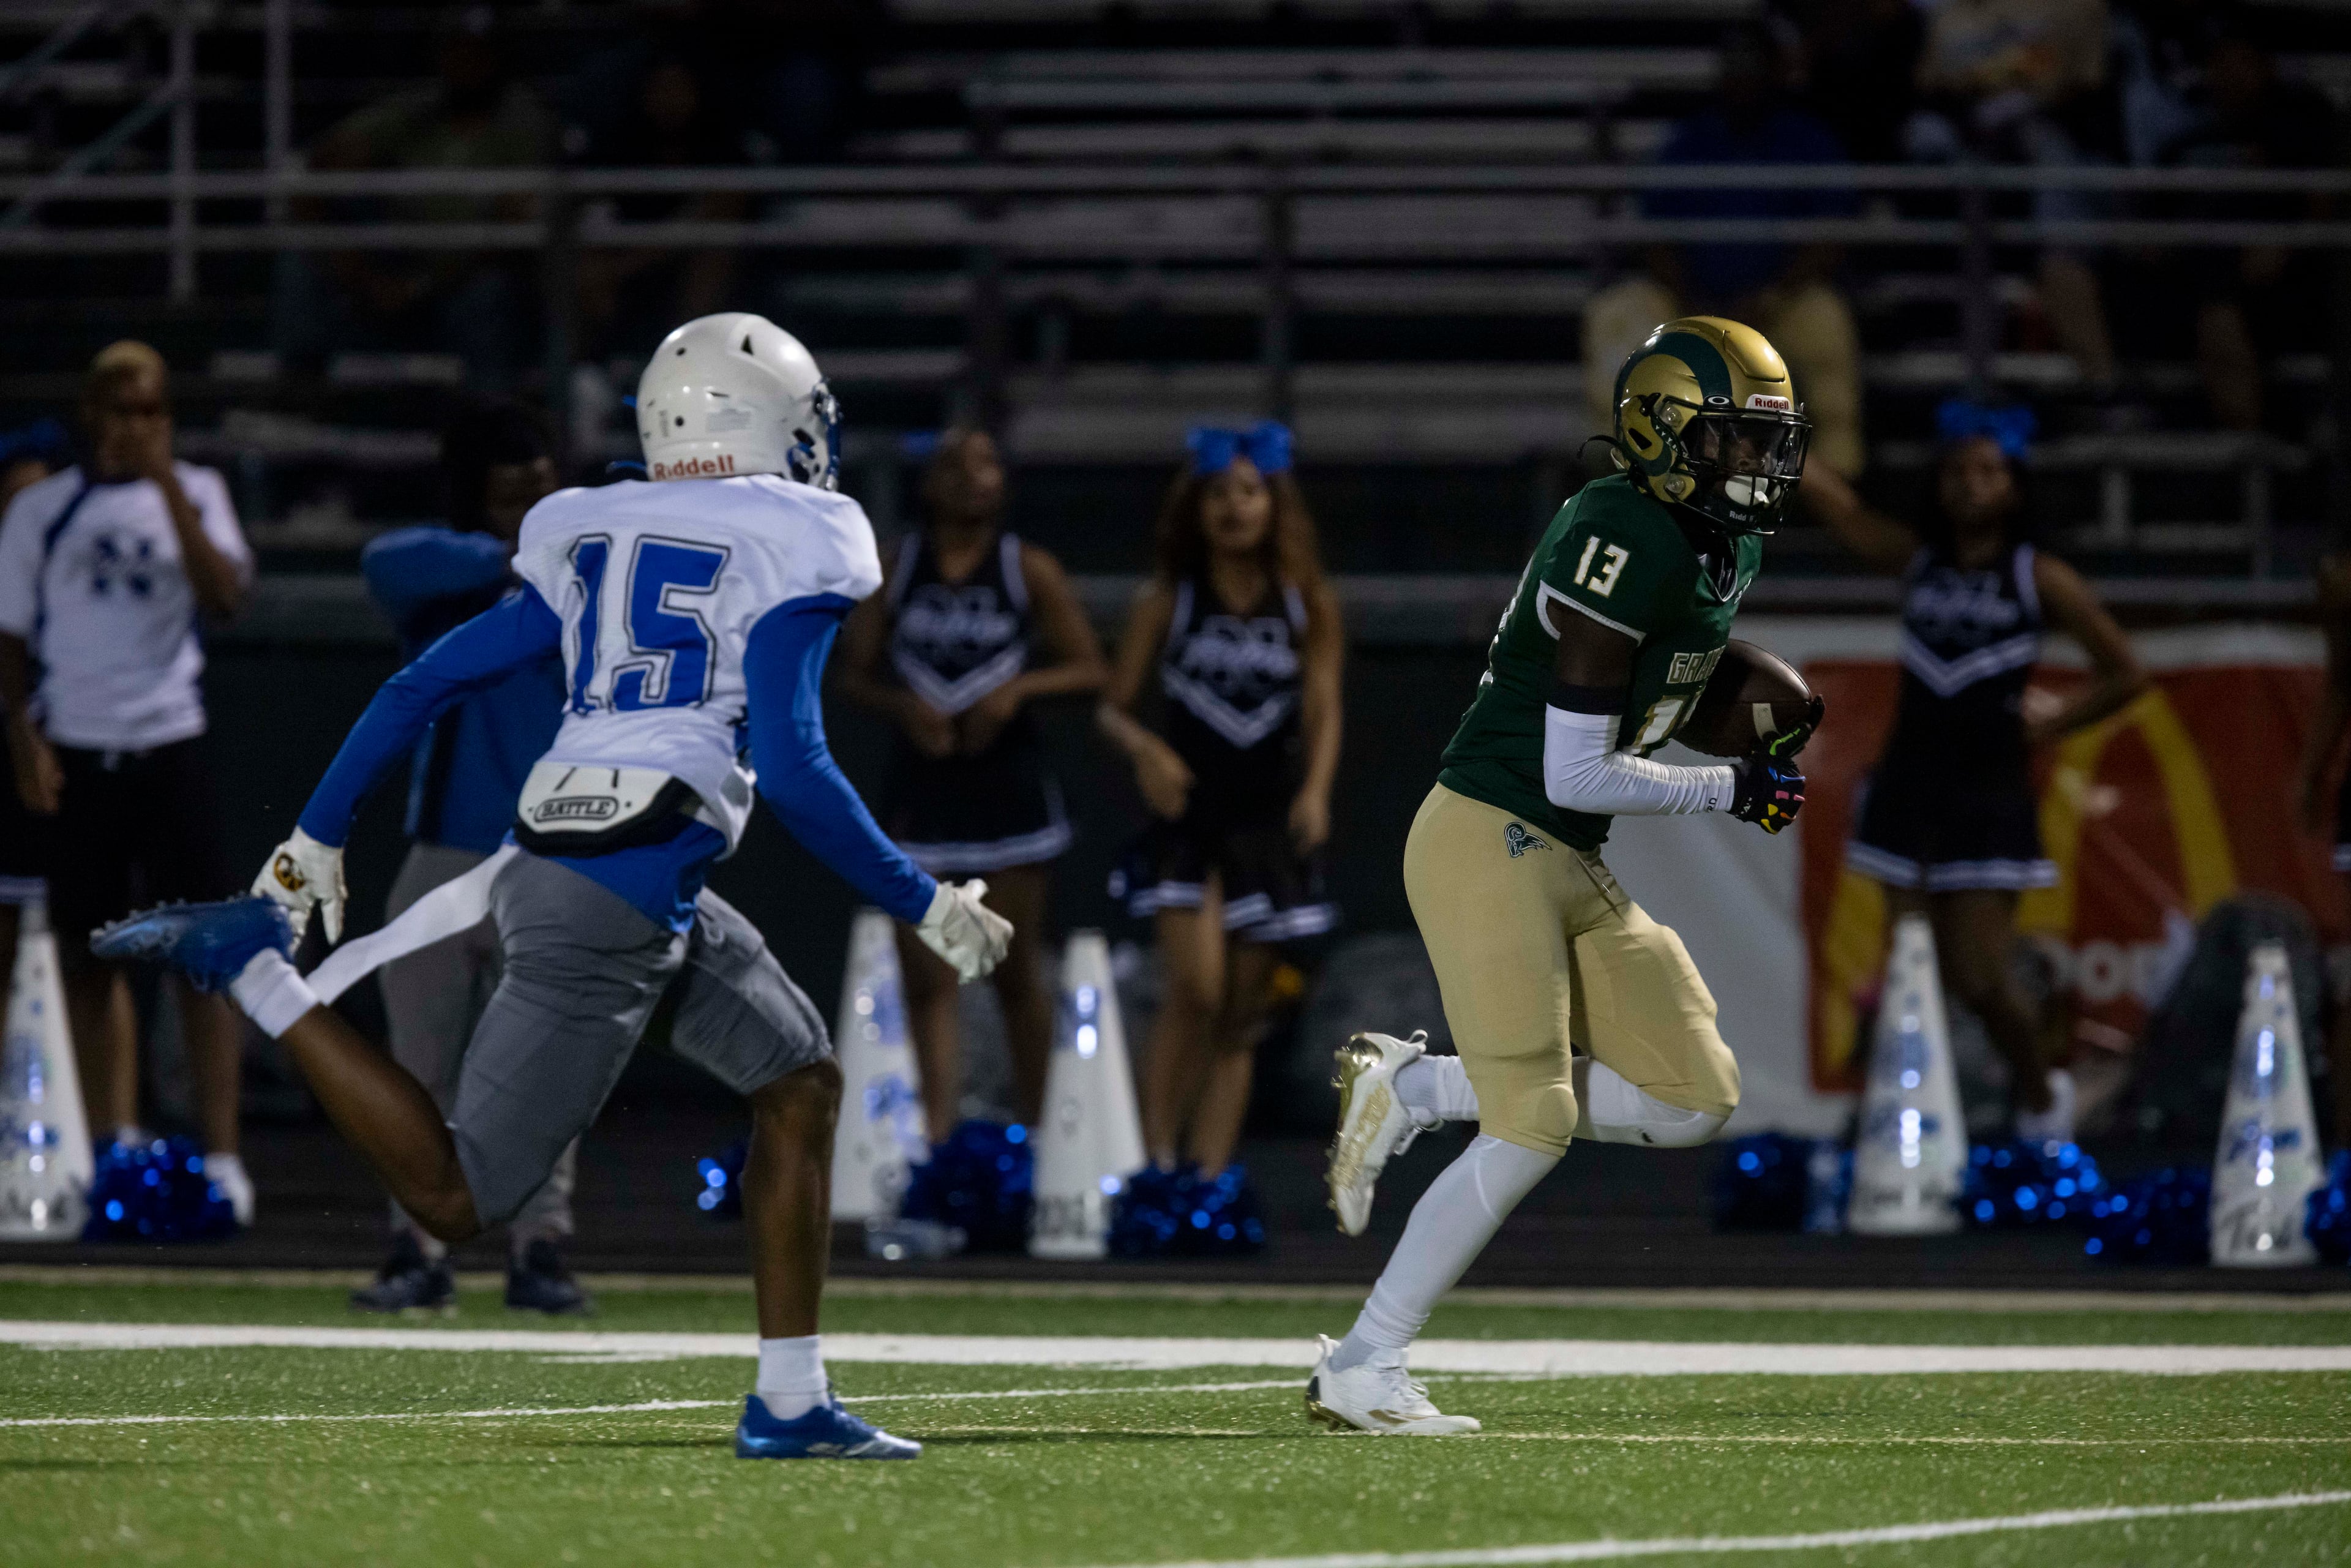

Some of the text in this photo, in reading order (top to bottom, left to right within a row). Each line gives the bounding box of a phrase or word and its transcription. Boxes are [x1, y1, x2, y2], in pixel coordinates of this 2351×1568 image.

[1755, 397, 1790, 410] Riddell
[654, 454, 734, 479] Riddell
[1729, 510, 1755, 523] Riddll
[1574, 535, 1630, 598] 13
[568, 532, 731, 715] 15
[541, 799, 612, 817] BATTLE
